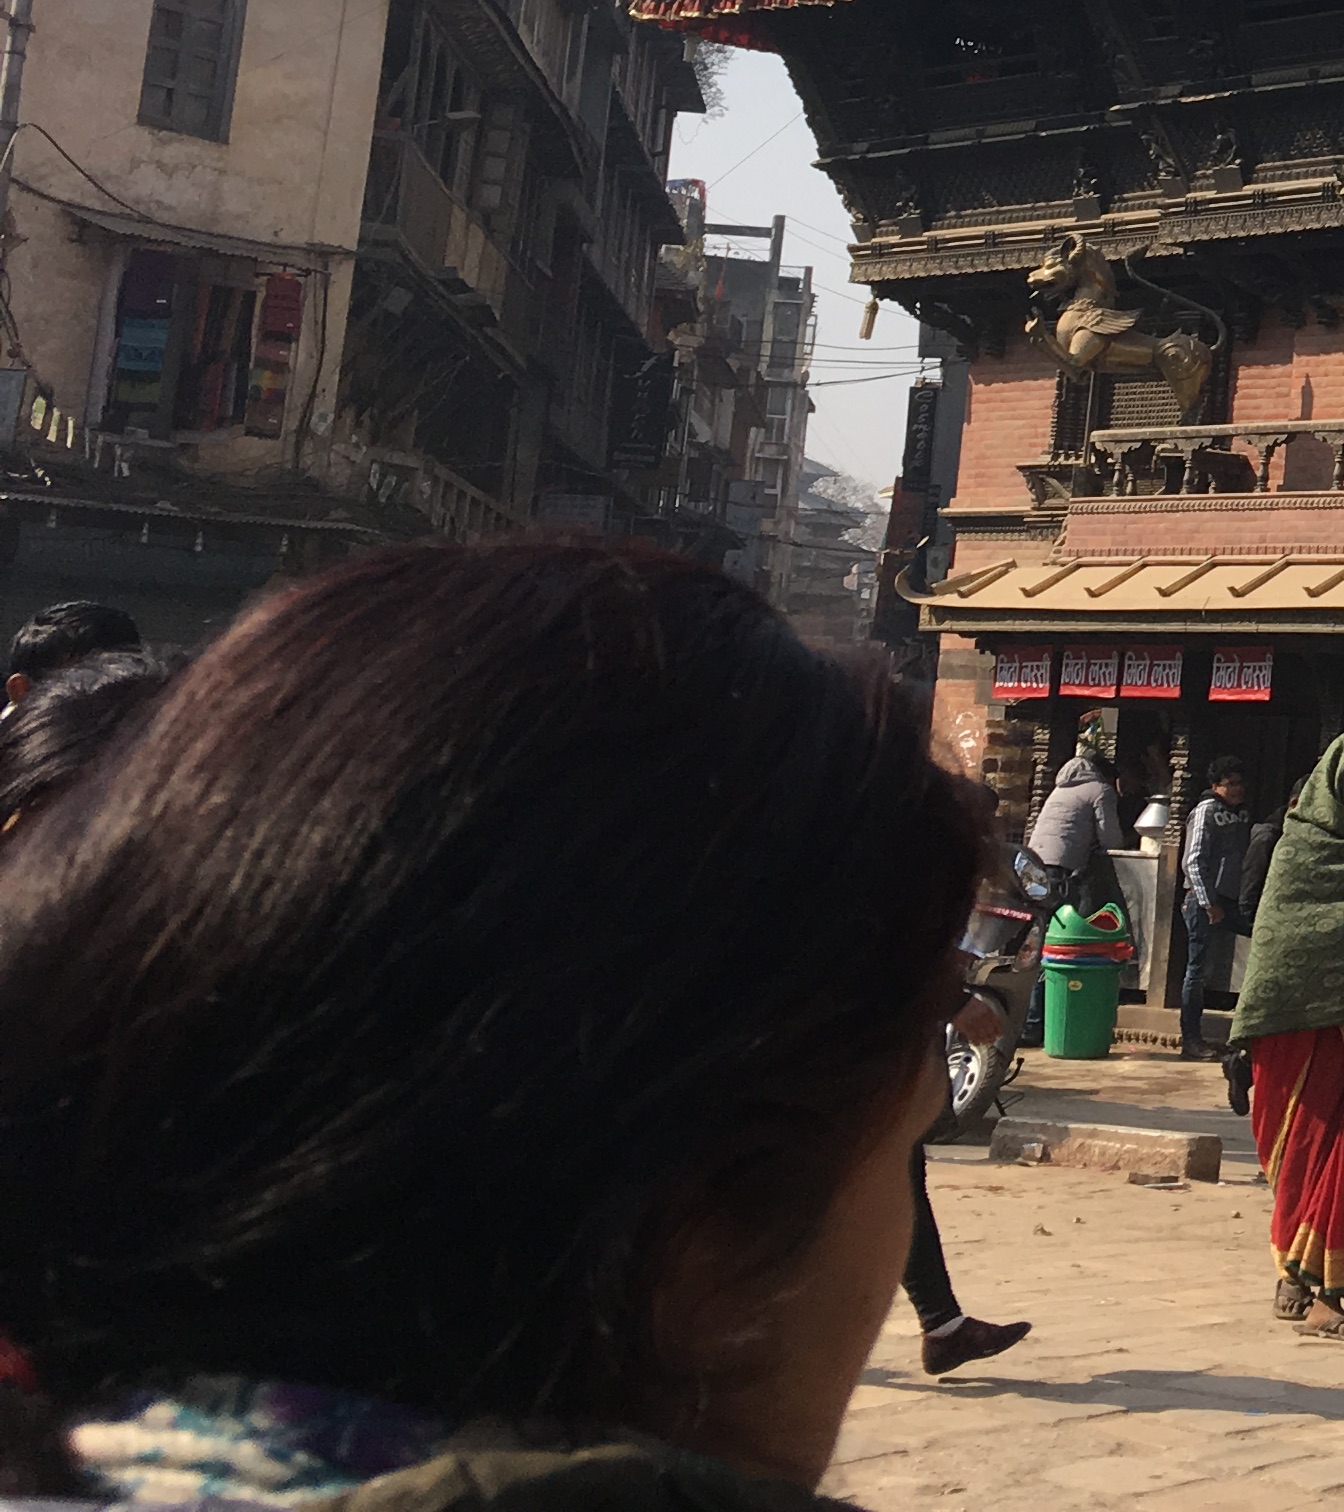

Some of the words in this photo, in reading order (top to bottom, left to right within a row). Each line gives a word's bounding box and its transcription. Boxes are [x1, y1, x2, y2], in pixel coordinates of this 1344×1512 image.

[996, 653, 1019, 687] मिठो
[1020, 653, 1051, 688] लस्सी
[1061, 650, 1087, 685] मिठो
[1088, 650, 1119, 686] लस्सी
[1123, 652, 1150, 685] मिठो
[1151, 651, 1183, 688] लस्सी
[1211, 653, 1240, 688] मिठो
[1241, 653, 1273, 690] लस्सी
